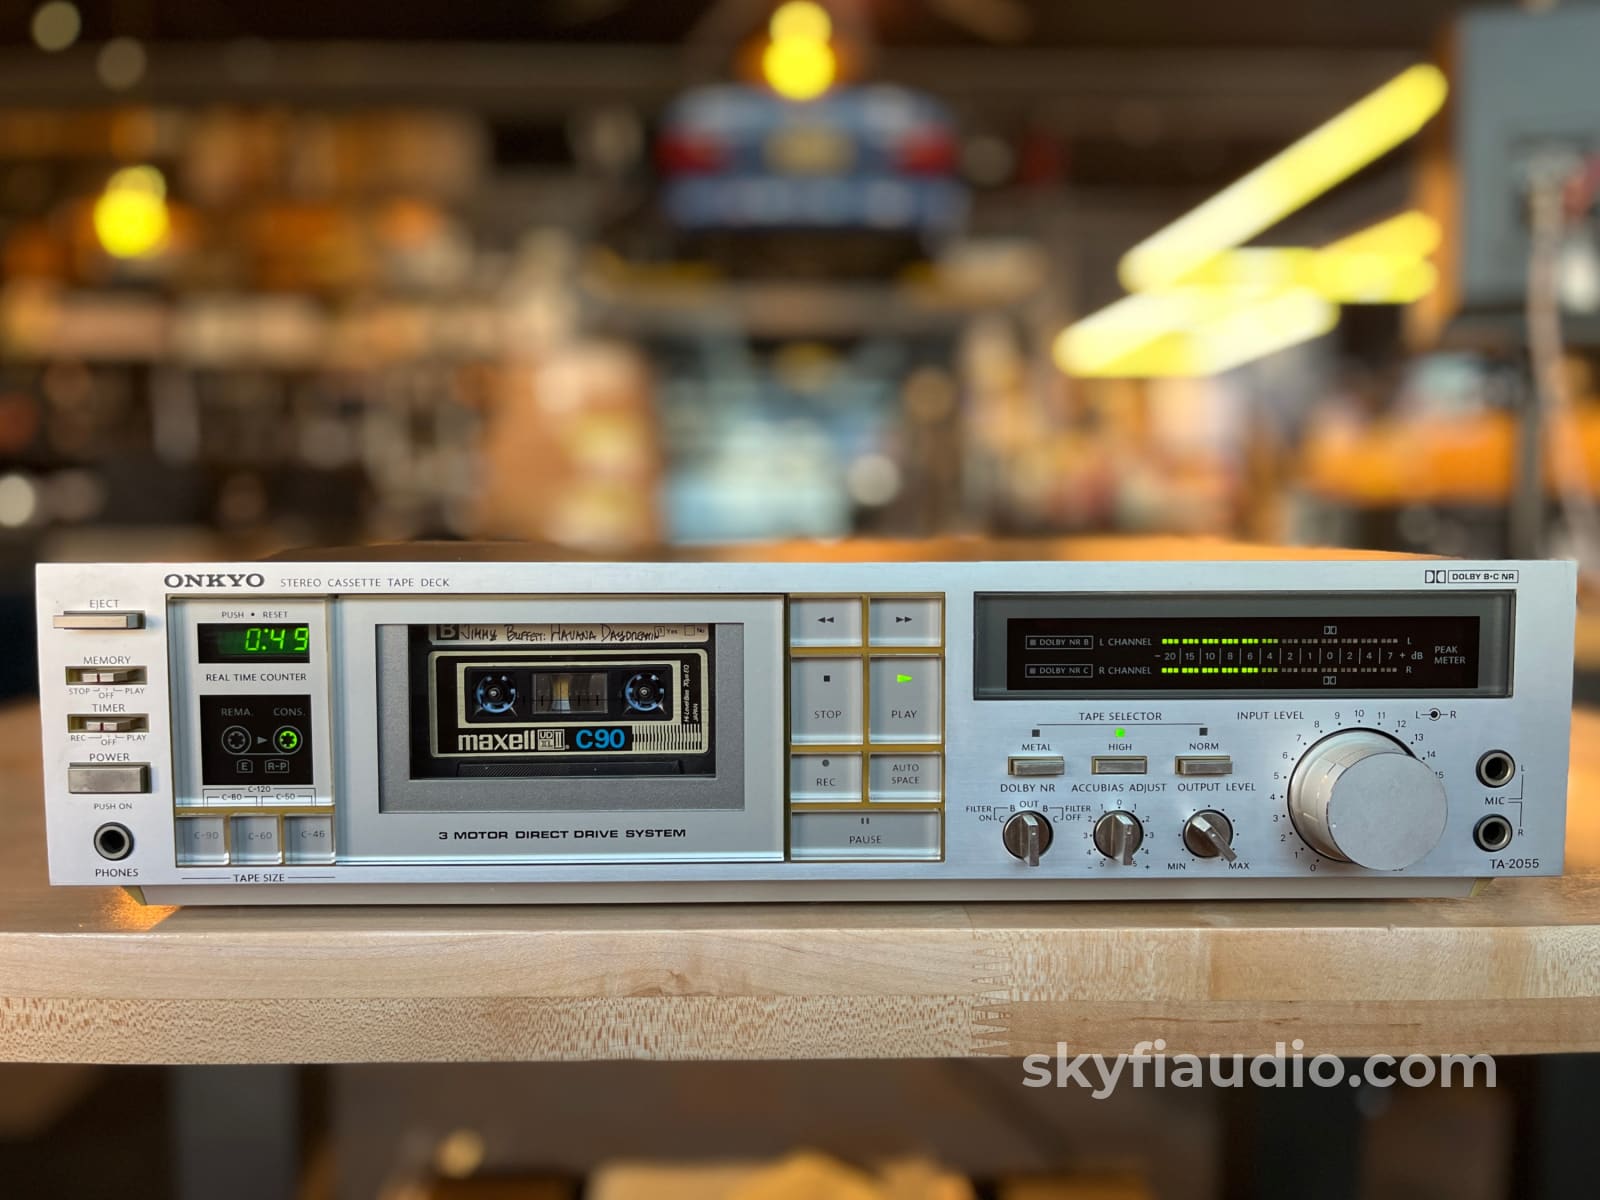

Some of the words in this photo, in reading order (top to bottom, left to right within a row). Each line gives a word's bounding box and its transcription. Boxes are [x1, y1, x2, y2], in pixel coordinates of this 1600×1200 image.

[164, 573, 265, 588] ONKYO
[280, 578, 322, 588] STEREO
[327, 578, 381, 588] CASSETTE
[388, 578, 414, 588] TAPE
[421, 578, 450, 587] DECK
[89, 600, 120, 609] EJECT
[221, 611, 245, 619] PUSH
[263, 611, 288, 619] RESET
[1099, 638, 1104, 646] L
[1108, 638, 1152, 646] CHANNEL
[1407, 637, 1412, 645] L
[1434, 646, 1458, 654] PEAK
[1185, 652, 1195, 660] 15
[1205, 652, 1216, 660] 10
[1227, 652, 1233, 660] 8
[1247, 652, 1253, 660] 6
[1267, 652, 1273, 660] 4
[1287, 652, 1293, 660] 2
[1308, 652, 1312, 660] 1
[1327, 652, 1333, 660] 0
[1347, 652, 1353, 660] 2
[1366, 652, 1372, 660] 4
[1387, 652, 1392, 660] 7
[1411, 652, 1423, 660] dB
[1434, 656, 1465, 664] METER
[83, 656, 131, 665] MEMORY
[1099, 667, 1105, 675] R
[1107, 667, 1151, 675] CHANNEL
[206, 674, 230, 682] REAL
[234, 673, 257, 682] TIME
[260, 673, 307, 681] COUNTER
[92, 704, 126, 713] TIMER
[273, 707, 306, 716] CONS.
[814, 710, 842, 719] STOP
[891, 710, 918, 719] PLAY
[1079, 712, 1105, 721] TAPE
[1109, 711, 1162, 721] SELECTOR
[1237, 711, 1268, 720] INPUT
[1274, 711, 1304, 720] LEVEL
[1378, 711, 1385, 719] 11
[1416, 711, 1420, 719] L
[1397, 720, 1406, 728] 12
[458, 730, 535, 750] maxell
[576, 729, 625, 748] C90
[1415, 734, 1424, 742] 13
[1108, 743, 1132, 751] HIGH
[1189, 742, 1219, 750] NORM
[89, 753, 130, 761] POWER
[1282, 752, 1288, 760] 6
[241, 763, 248, 771] E
[892, 764, 919, 772] AUTO
[1273, 772, 1279, 780] 5
[816, 778, 837, 787] REC
[891, 776, 920, 785] SPACE
[1000, 784, 1036, 792] DOLBY
[1040, 784, 1056, 792] NR
[1071, 783, 1124, 792] ACCUBIAS
[1129, 783, 1166, 793] ADJUST
[1177, 783, 1220, 792] OUTPUT
[1226, 783, 1256, 791] LEVEL
[1019, 800, 1039, 808] OUT
[1485, 797, 1505, 805] MIC
[118, 802, 133, 810] ON
[998, 815, 1005, 823] C
[1052, 815, 1058, 823] C
[301, 830, 325, 838] C-46
[438, 831, 448, 840] 3
[454, 831, 508, 840] MOTOR
[515, 830, 569, 839] DIRECT
[574, 830, 619, 838] DRIVE
[625, 829, 686, 838] SYSTEM
[1280, 834, 1286, 842] 2
[849, 835, 882, 844] PAUSE
[1168, 862, 1186, 870] MIN
[1229, 862, 1250, 870] MAX
[1310, 864, 1316, 872] 0
[1490, 859, 1539, 869] TA-2055
[95, 868, 139, 877] PHONES
[233, 874, 260, 882] TAPE
[263, 874, 285, 882] SIZE
